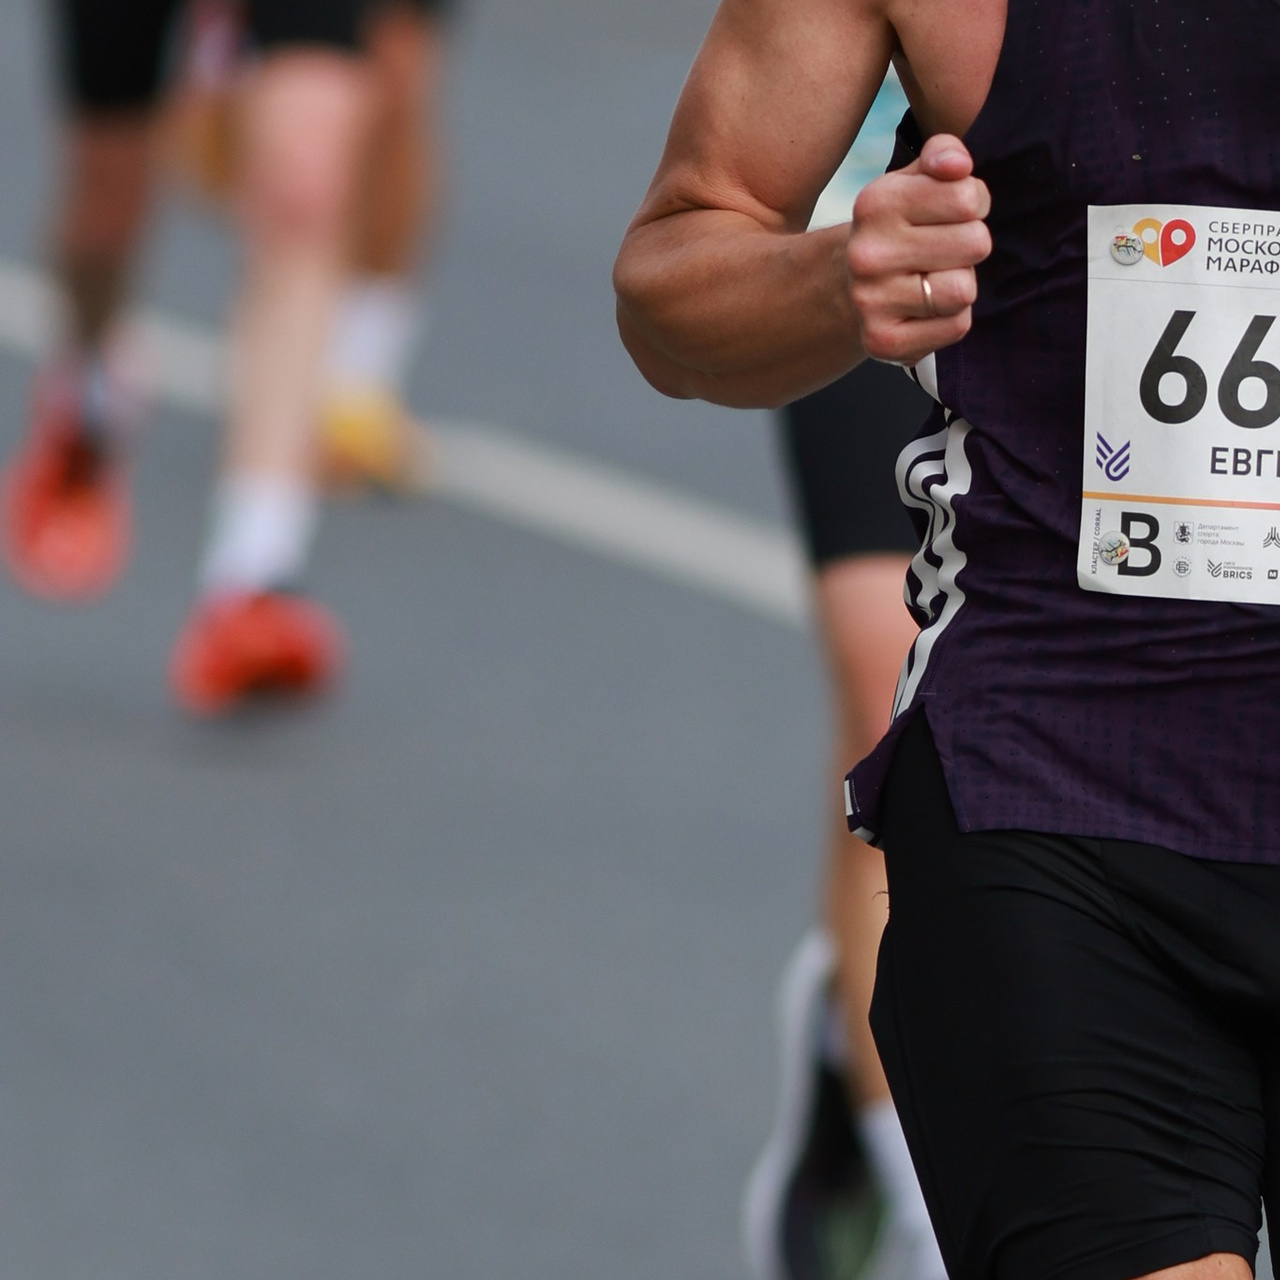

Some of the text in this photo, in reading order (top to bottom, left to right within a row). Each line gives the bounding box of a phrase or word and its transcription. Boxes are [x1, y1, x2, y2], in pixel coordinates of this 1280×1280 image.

[1094, 507, 1102, 536] CORRAL
[1197, 523, 1240, 532] Департамент
[1197, 538, 1245, 547] города Москвы
[1091, 540, 1099, 575] КЛАСТЕР
[1223, 570, 1253, 580] BRICS
